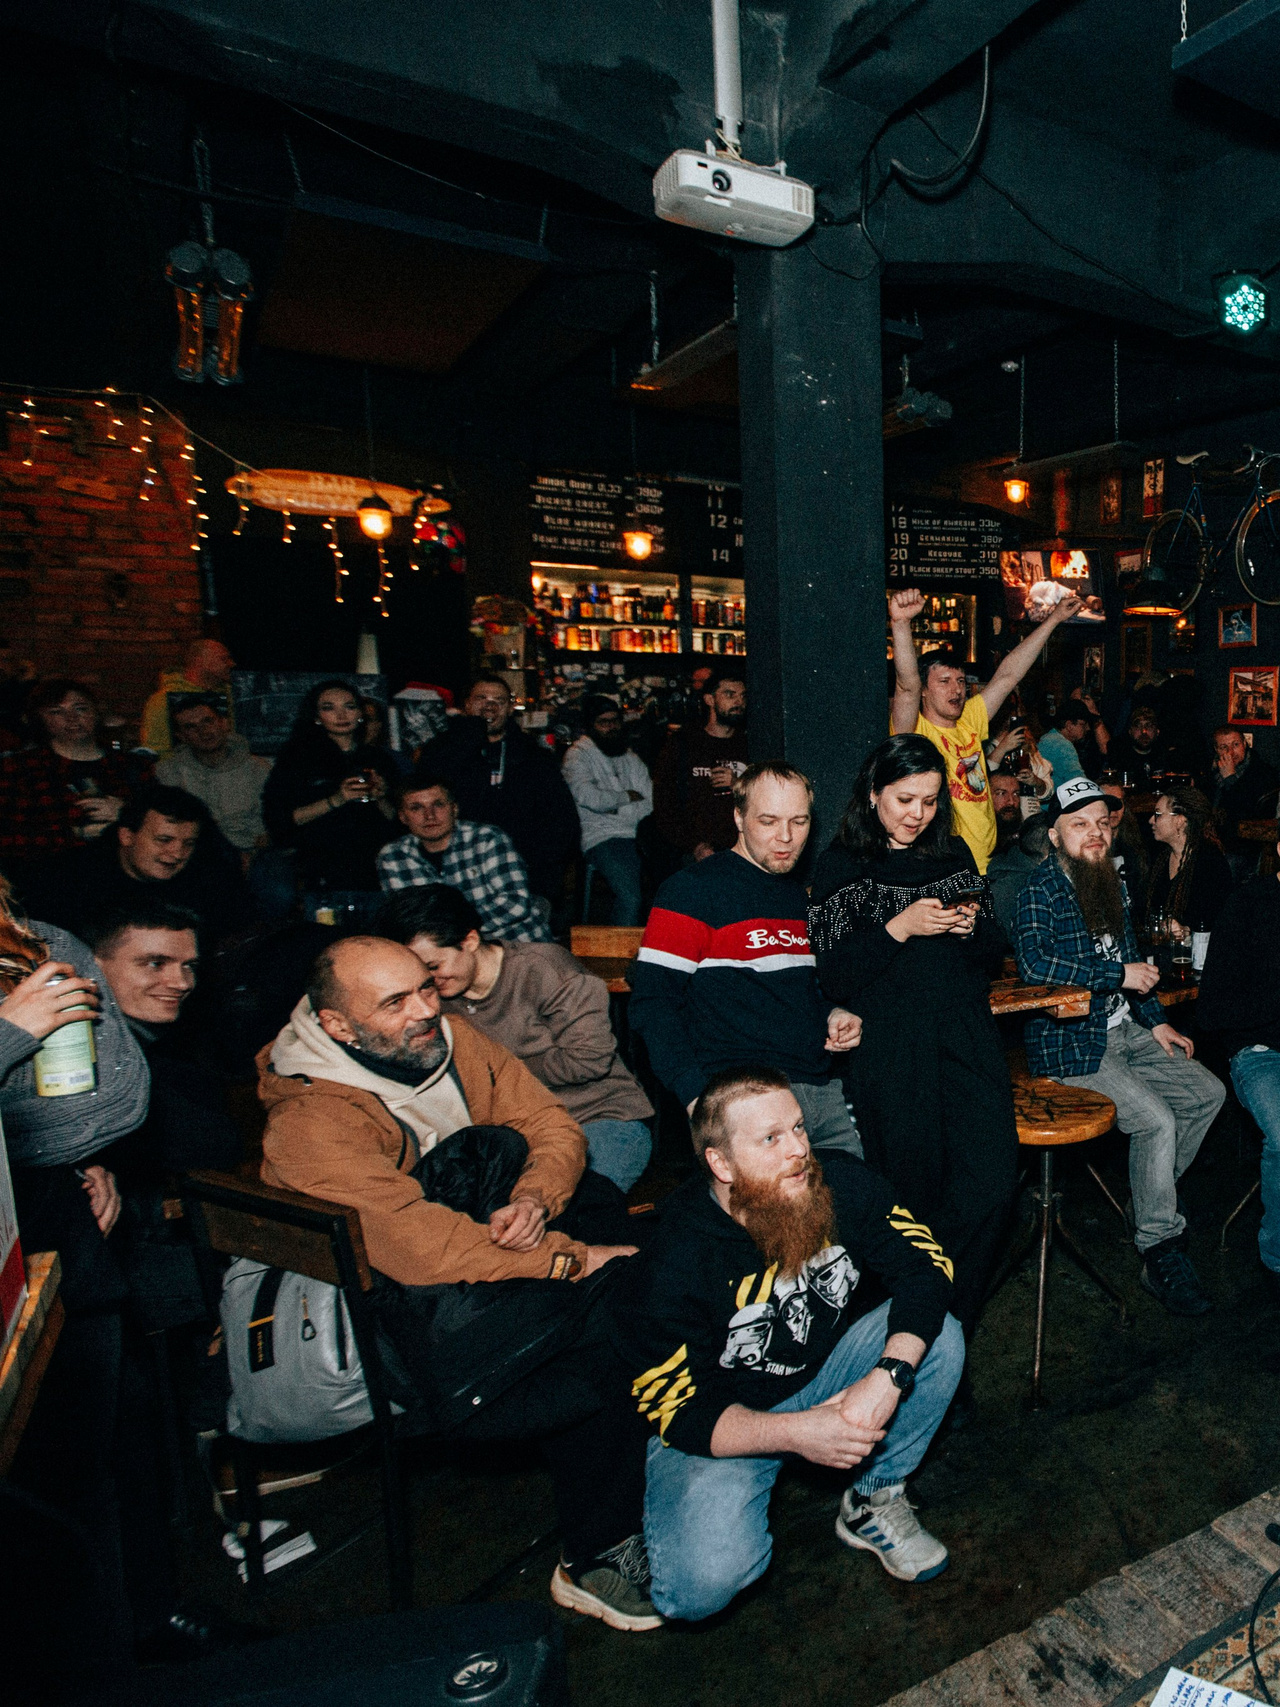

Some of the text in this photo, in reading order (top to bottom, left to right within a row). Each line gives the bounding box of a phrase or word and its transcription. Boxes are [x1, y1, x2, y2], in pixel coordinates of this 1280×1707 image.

[710, 513, 728, 529] 12
[891, 516, 907, 529] 18
[894, 532, 910, 545] 19
[712, 548, 730, 563] 14
[889, 547, 908, 561] 20
[889, 564, 907, 577] 21
[909, 565, 931, 573] BLACK
[932, 566, 954, 574] SHEEP
[765, 1361, 807, 1376] STAR WA
